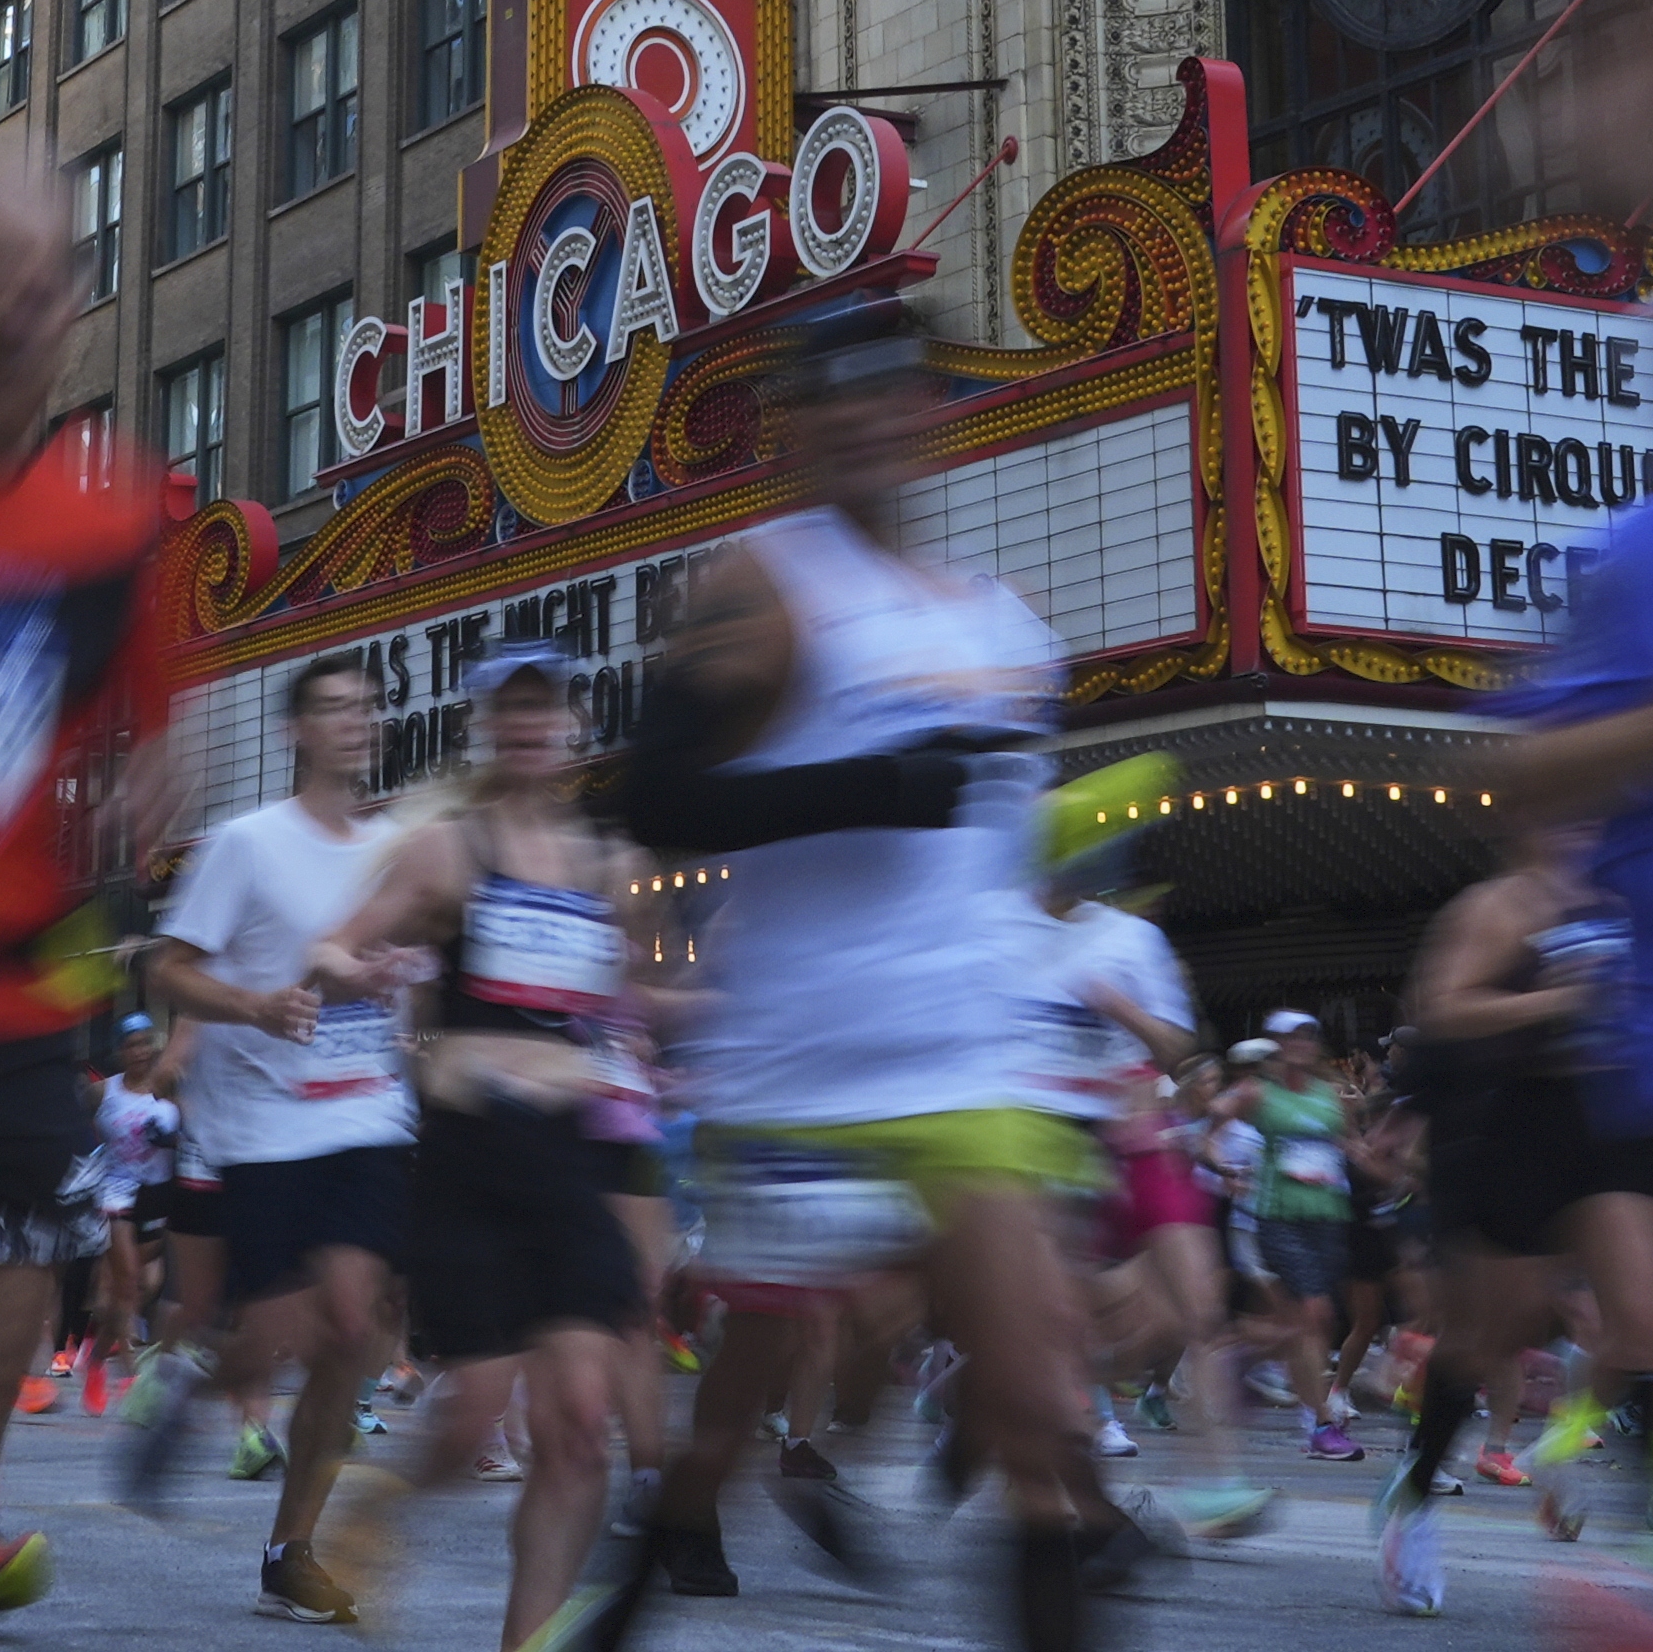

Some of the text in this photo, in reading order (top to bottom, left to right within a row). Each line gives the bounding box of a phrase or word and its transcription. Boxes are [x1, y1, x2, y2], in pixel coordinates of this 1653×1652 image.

[334, 105, 882, 456] CHICAGO
[1294, 295, 1493, 388] 'TWAS
[1521, 324, 1641, 408] THE
[1336, 410, 1422, 488] BY
